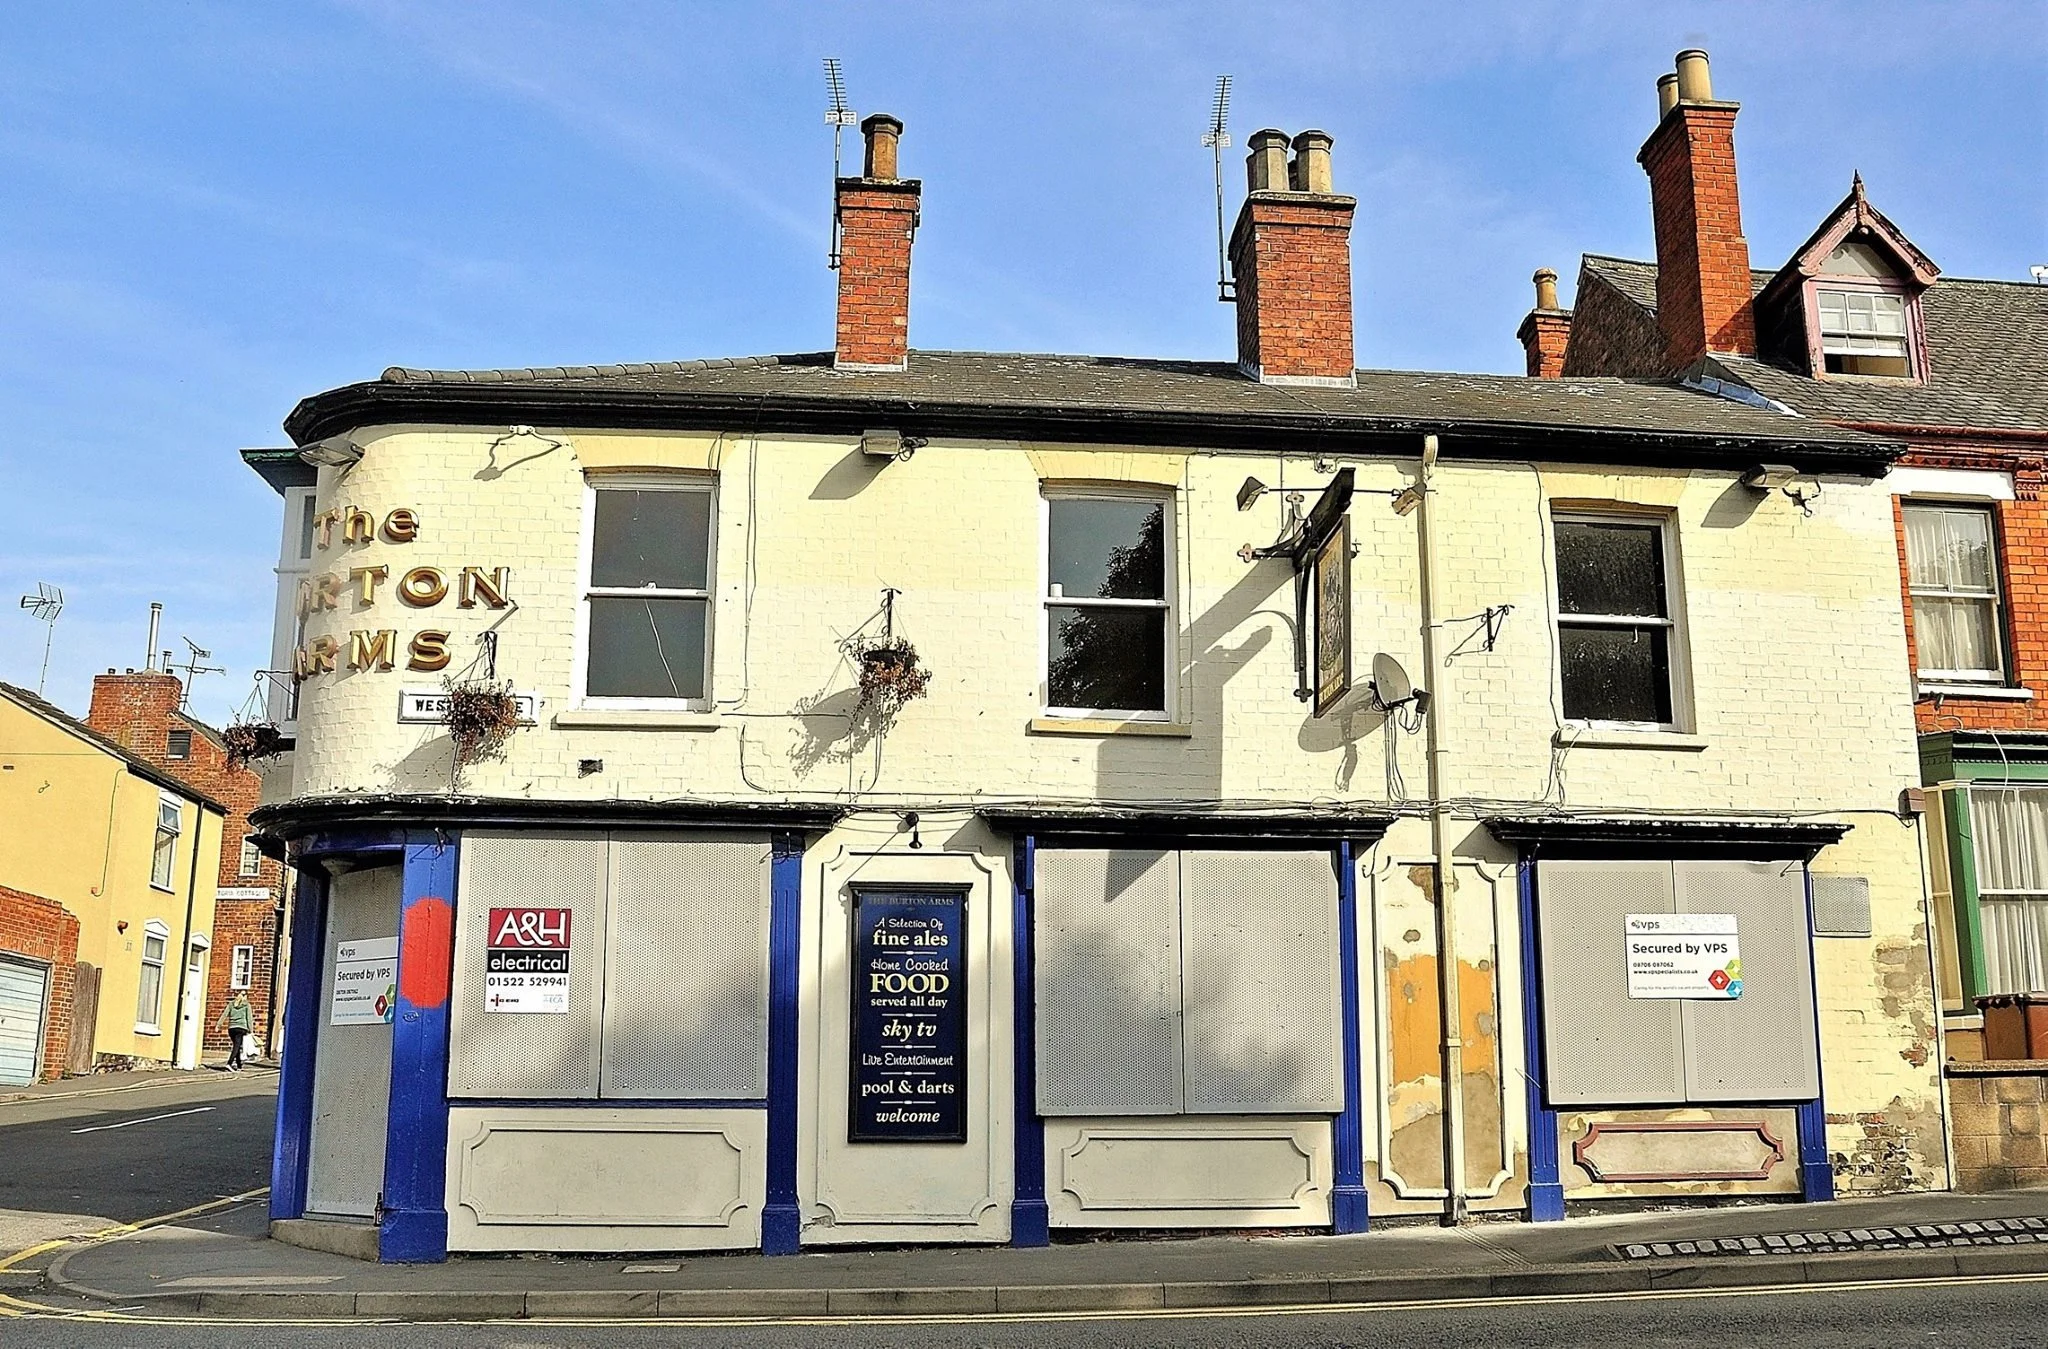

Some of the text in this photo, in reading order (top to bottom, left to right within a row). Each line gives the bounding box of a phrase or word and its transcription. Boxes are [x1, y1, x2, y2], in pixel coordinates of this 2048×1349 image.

[313, 505, 420, 549] The
[889, 897, 926, 905] BURTON
[928, 898, 955, 906] ARMS
[494, 911, 566, 946] A&H
[874, 917, 944, 931] A Selection Of
[872, 929, 949, 947] fine ales
[1632, 943, 1728, 955] Secured by VPS
[490, 952, 567, 971] electrical
[870, 958, 949, 971] Home Cooked
[337, 967, 391, 981] Secured by VPS
[488, 977, 567, 987] 01522 529941
[869, 973, 950, 994] FOOD
[870, 995, 948, 1009] served all day
[881, 1019, 937, 1042] sky tv
[862, 1052, 954, 1066] Live Entertainment
[862, 1079, 955, 1097] pool & darts
[875, 1108, 941, 1123] welcome
